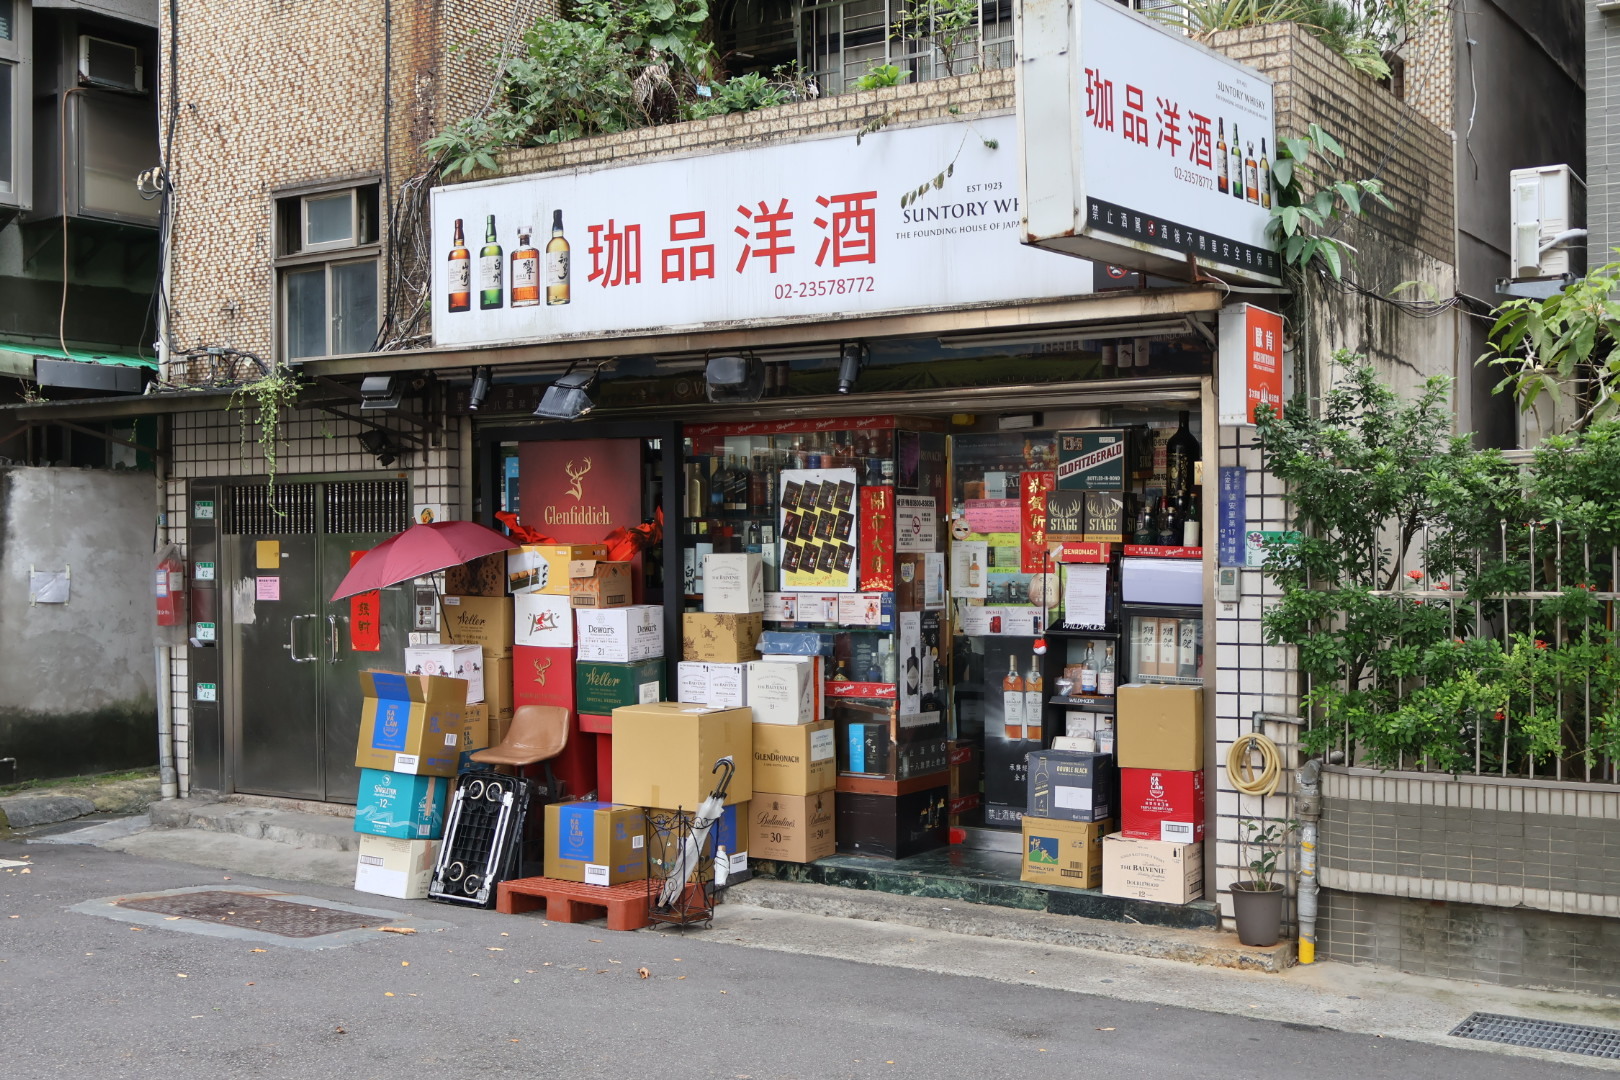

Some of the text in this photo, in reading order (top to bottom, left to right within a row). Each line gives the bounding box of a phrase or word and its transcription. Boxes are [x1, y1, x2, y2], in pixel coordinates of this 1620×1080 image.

[1217, 80, 1244, 101] SUNTORY
[1084, 67, 1213, 171] 珈品洋酒
[1173, 166, 1214, 191] 02-23578772
[966, 181, 1003, 194] EST 1923
[903, 202, 988, 224] SUNTORY
[896, 231, 911, 241] THE
[912, 227, 958, 239] FOUNDING
[958, 224, 988, 235] HOUSE
[988, 222, 1001, 232] OF
[587, 190, 878, 288] 珈品洋酒
[774, 276, 875, 300] 02-23578772
[1060, 443, 1122, 477] OLD FITZGERALD
[200, 509, 208, 517] 42
[544, 505, 611, 526] Glenfiddich
[1027, 477, 1047, 545] 恭賀新禧
[1050, 517, 1078, 531] STAGG
[1089, 517, 1118, 531] STAGG
[1063, 548, 1098, 556] BENROMACH
[201, 570, 209, 578] 42
[683, 565, 695, 592] 白州
[457, 610, 487, 626] Weller
[202, 630, 210, 638] 42
[597, 647, 605, 656] 21
[644, 646, 650, 655] 21
[585, 666, 621, 687] Weller
[203, 691, 210, 699] 42
[1056, 765, 1088, 774] DOUBLE BLACK
[379, 798, 388, 808] 12
[757, 811, 796, 828] Ballantine's
[988, 808, 1016, 821] 禁止酒駕
[770, 832, 782, 843] 30
[816, 829, 824, 840] 30
[1132, 864, 1166, 875] BALVENIE
[1138, 890, 1146, 898] 12
